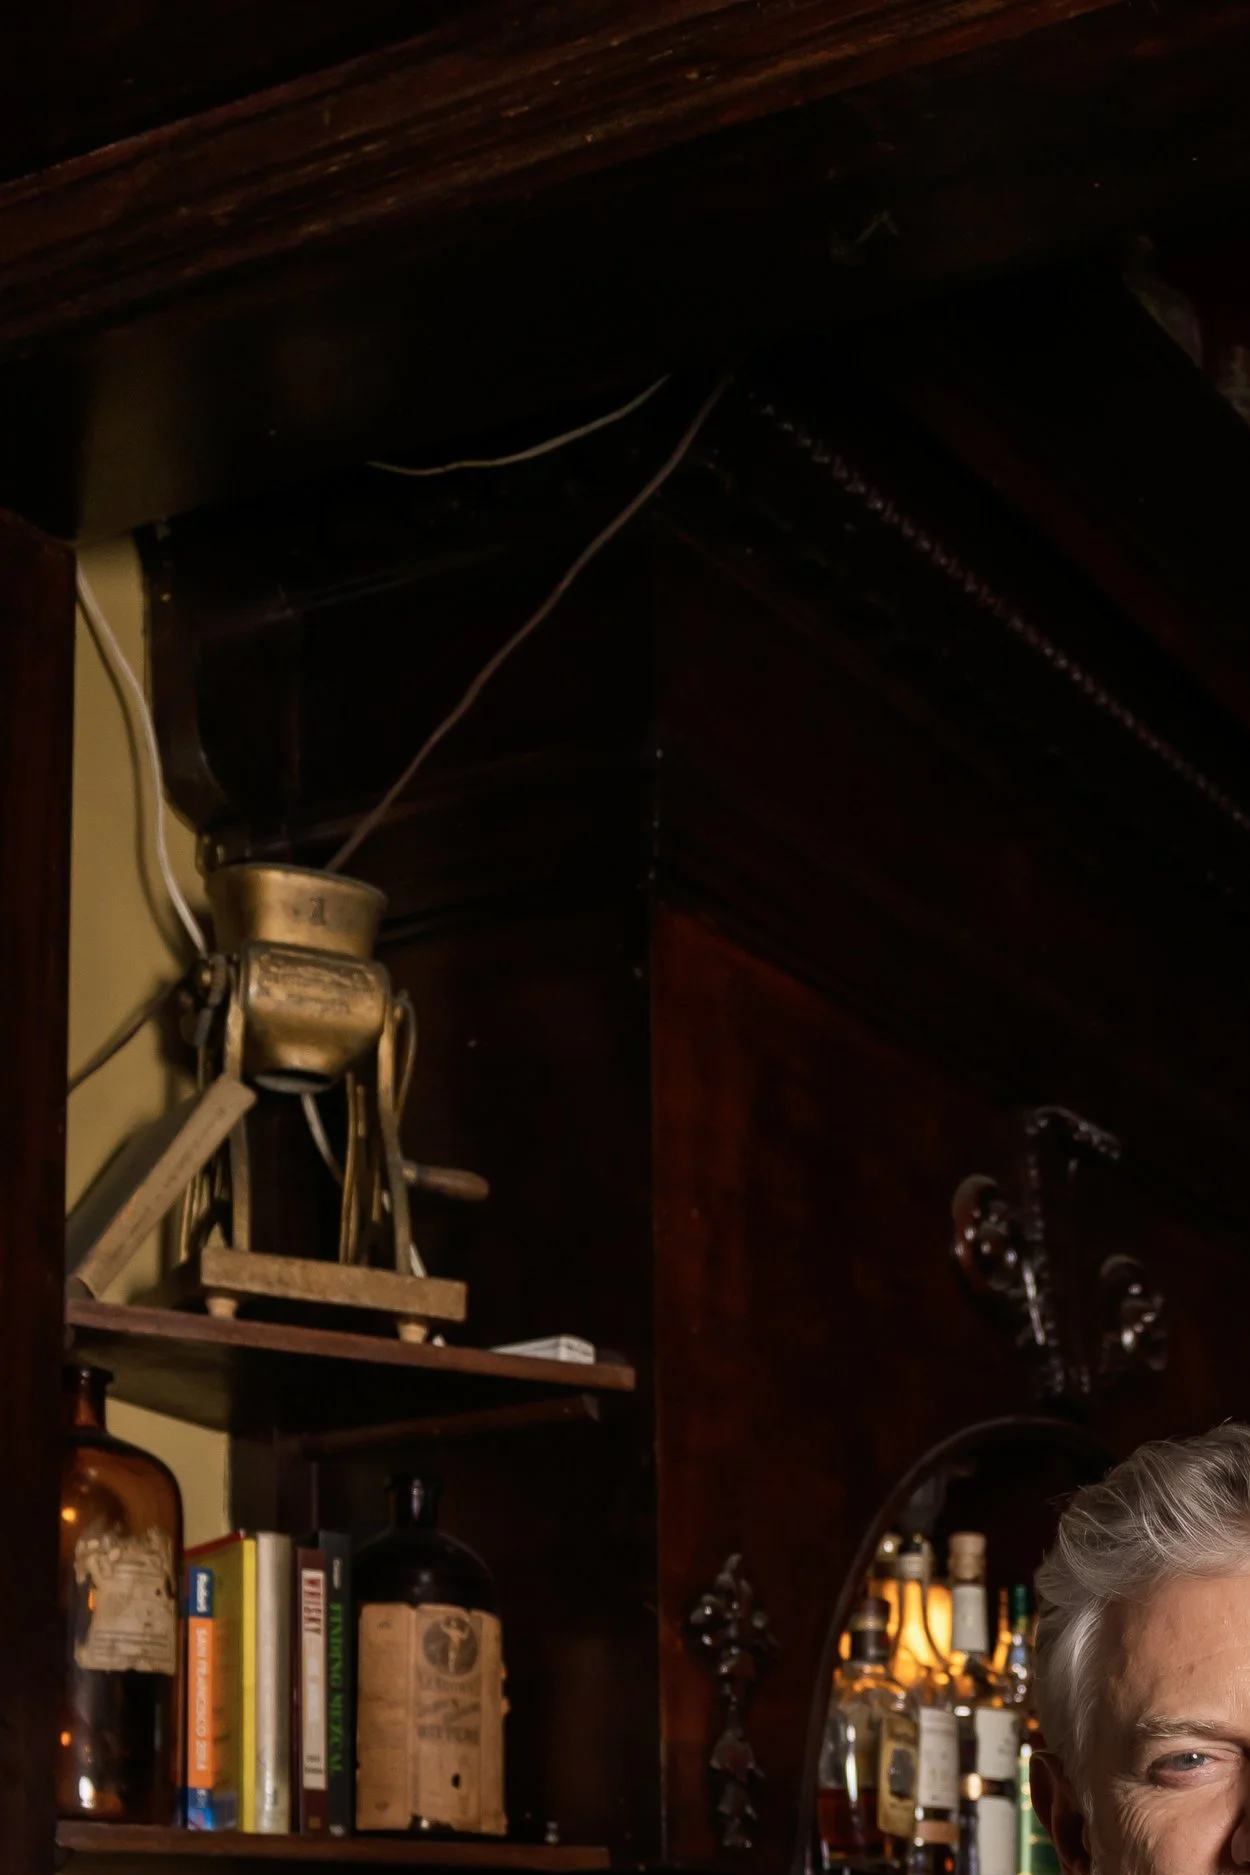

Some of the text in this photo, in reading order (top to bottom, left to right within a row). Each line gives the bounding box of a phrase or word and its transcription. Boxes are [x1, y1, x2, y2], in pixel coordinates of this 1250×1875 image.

[195, 1626, 208, 1656] SAN
[303, 1575, 322, 1635] WHISKY
[328, 1602, 344, 1689] FINDING
[195, 1658, 208, 1737] FRANCISCO
[328, 1692, 344, 1776] MEZCAL
